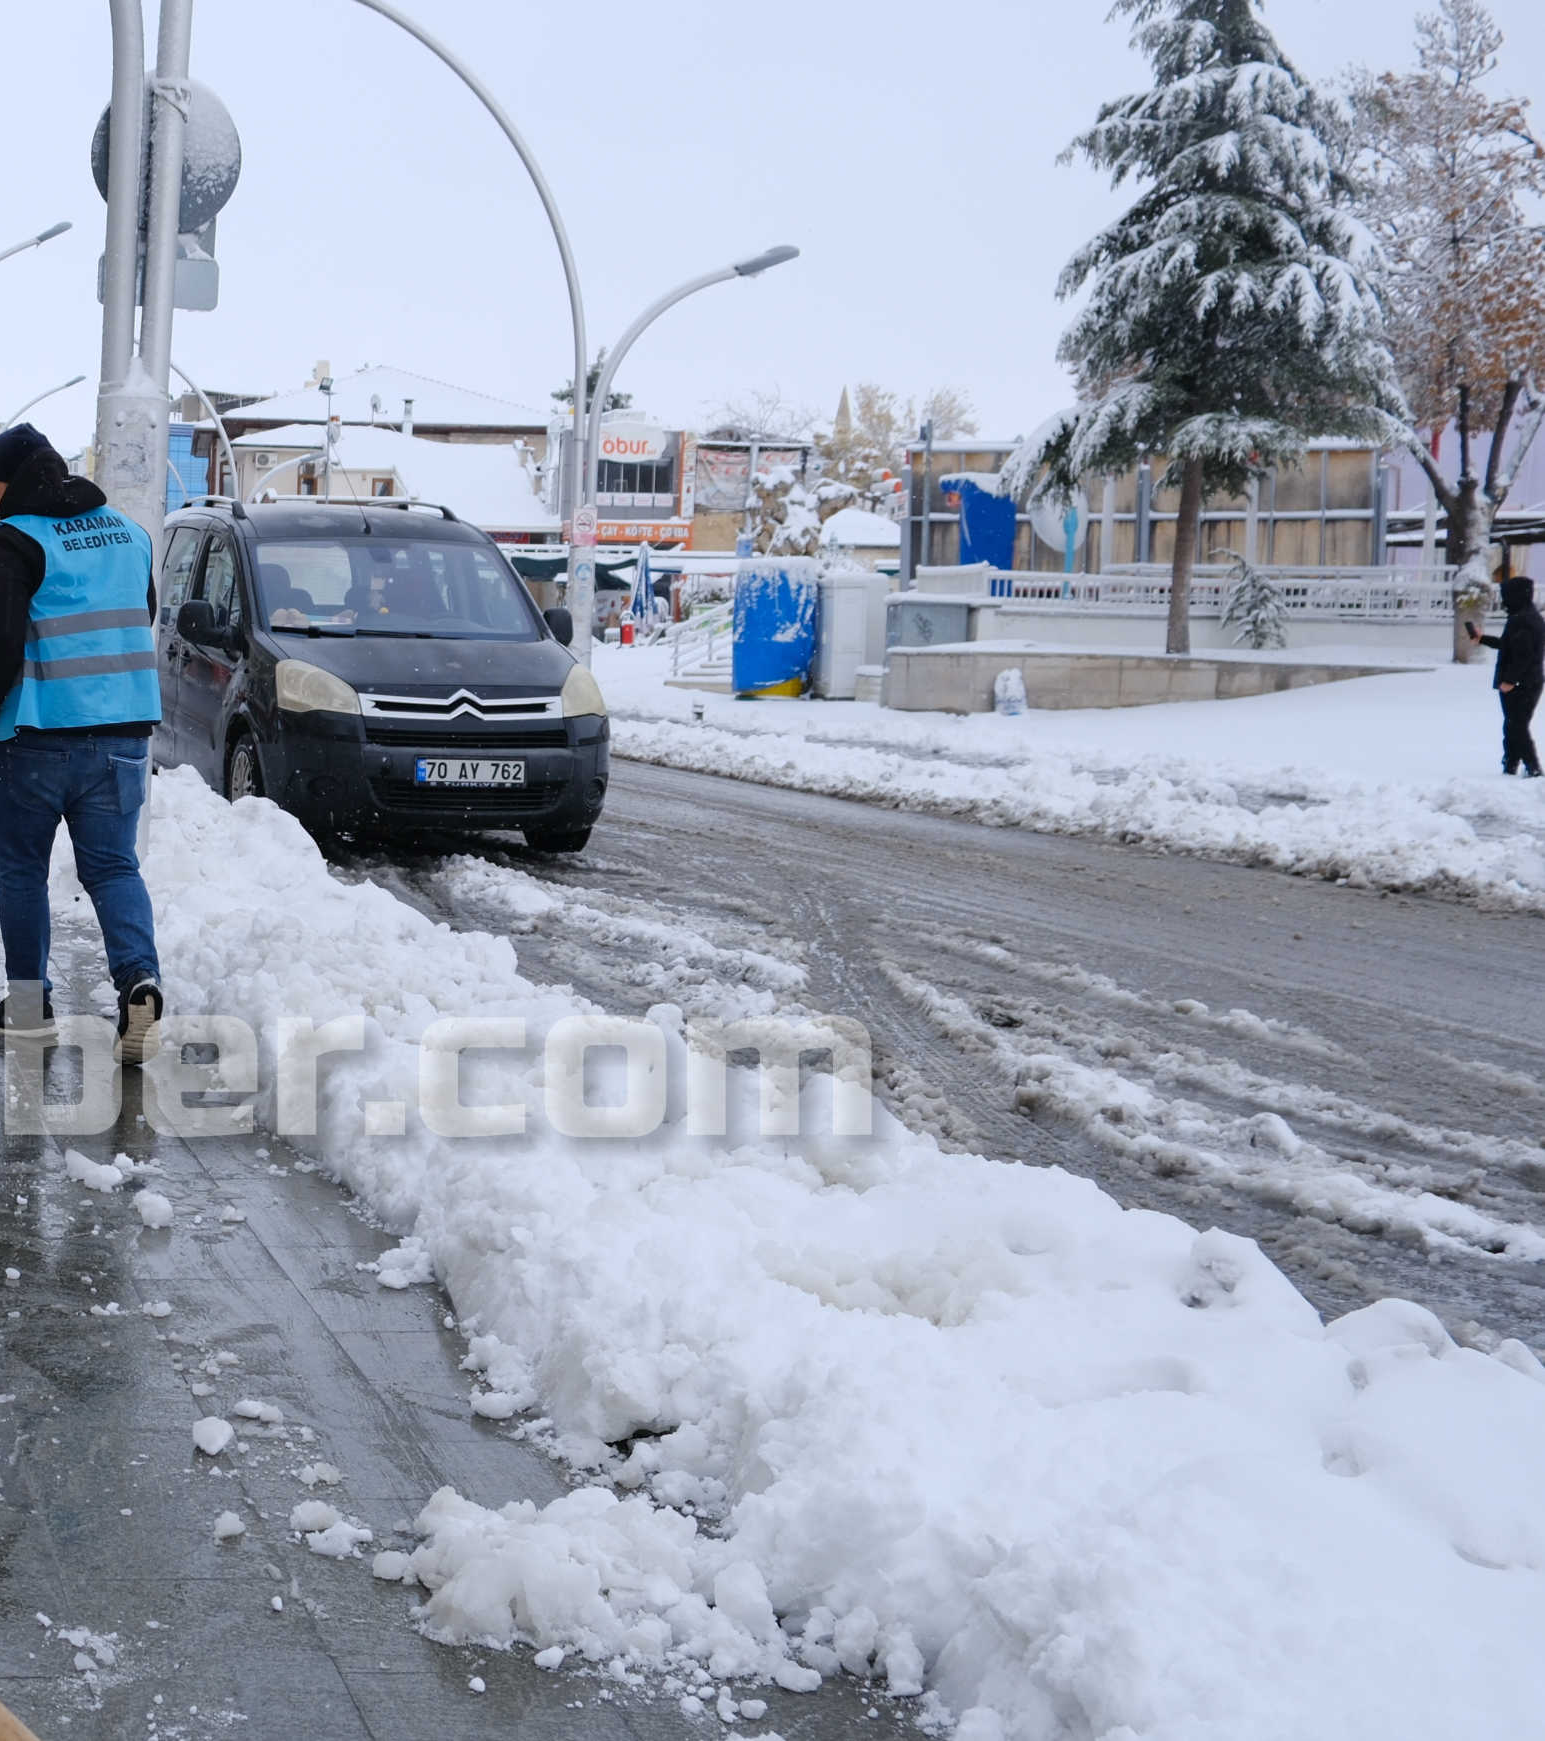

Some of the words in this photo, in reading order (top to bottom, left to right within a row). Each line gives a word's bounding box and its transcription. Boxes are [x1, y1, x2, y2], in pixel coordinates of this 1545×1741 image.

[52, 515, 126, 537] KARAMAN
[62, 531, 133, 552] BELEDİYESİ
[427, 761, 447, 779] 70
[459, 762, 480, 780] AY
[491, 763, 523, 781] 762
